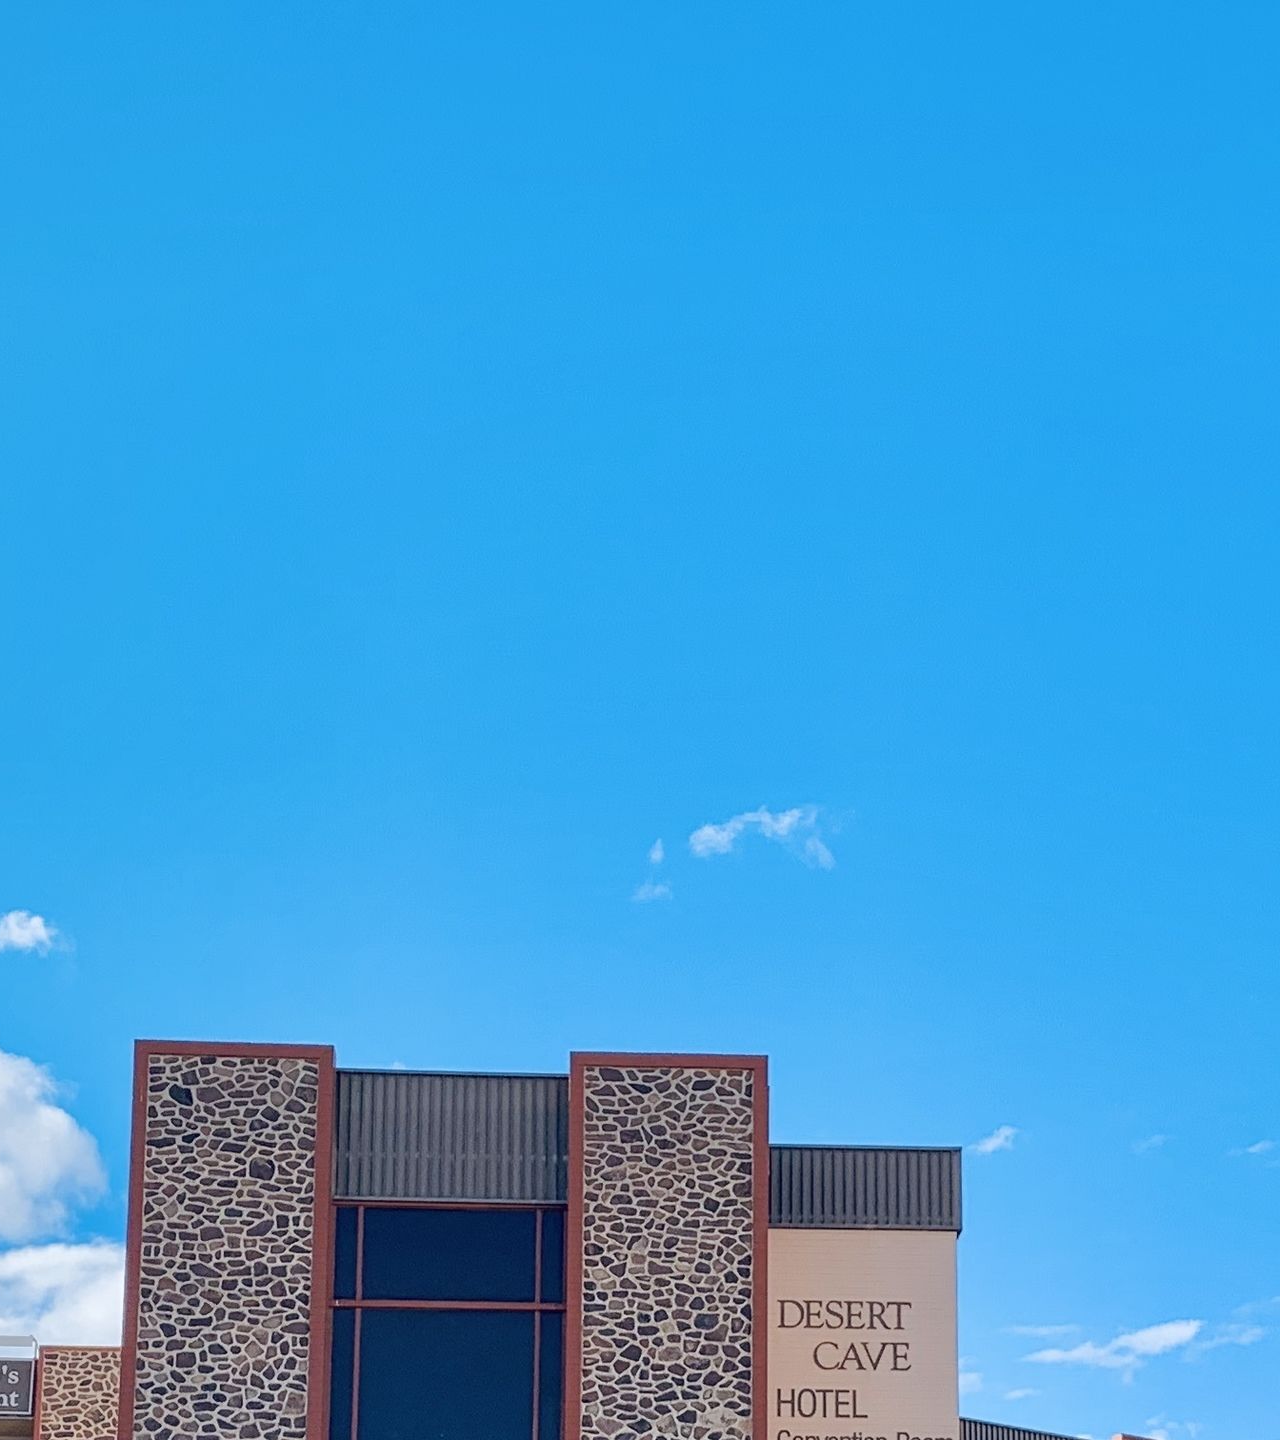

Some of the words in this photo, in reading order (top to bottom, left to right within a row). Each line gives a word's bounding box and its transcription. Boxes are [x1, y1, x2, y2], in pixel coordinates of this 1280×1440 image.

[777, 1299, 912, 1330] DESERT
[813, 1341, 912, 1371] CAVE
[777, 1388, 868, 1419] HOTEL
